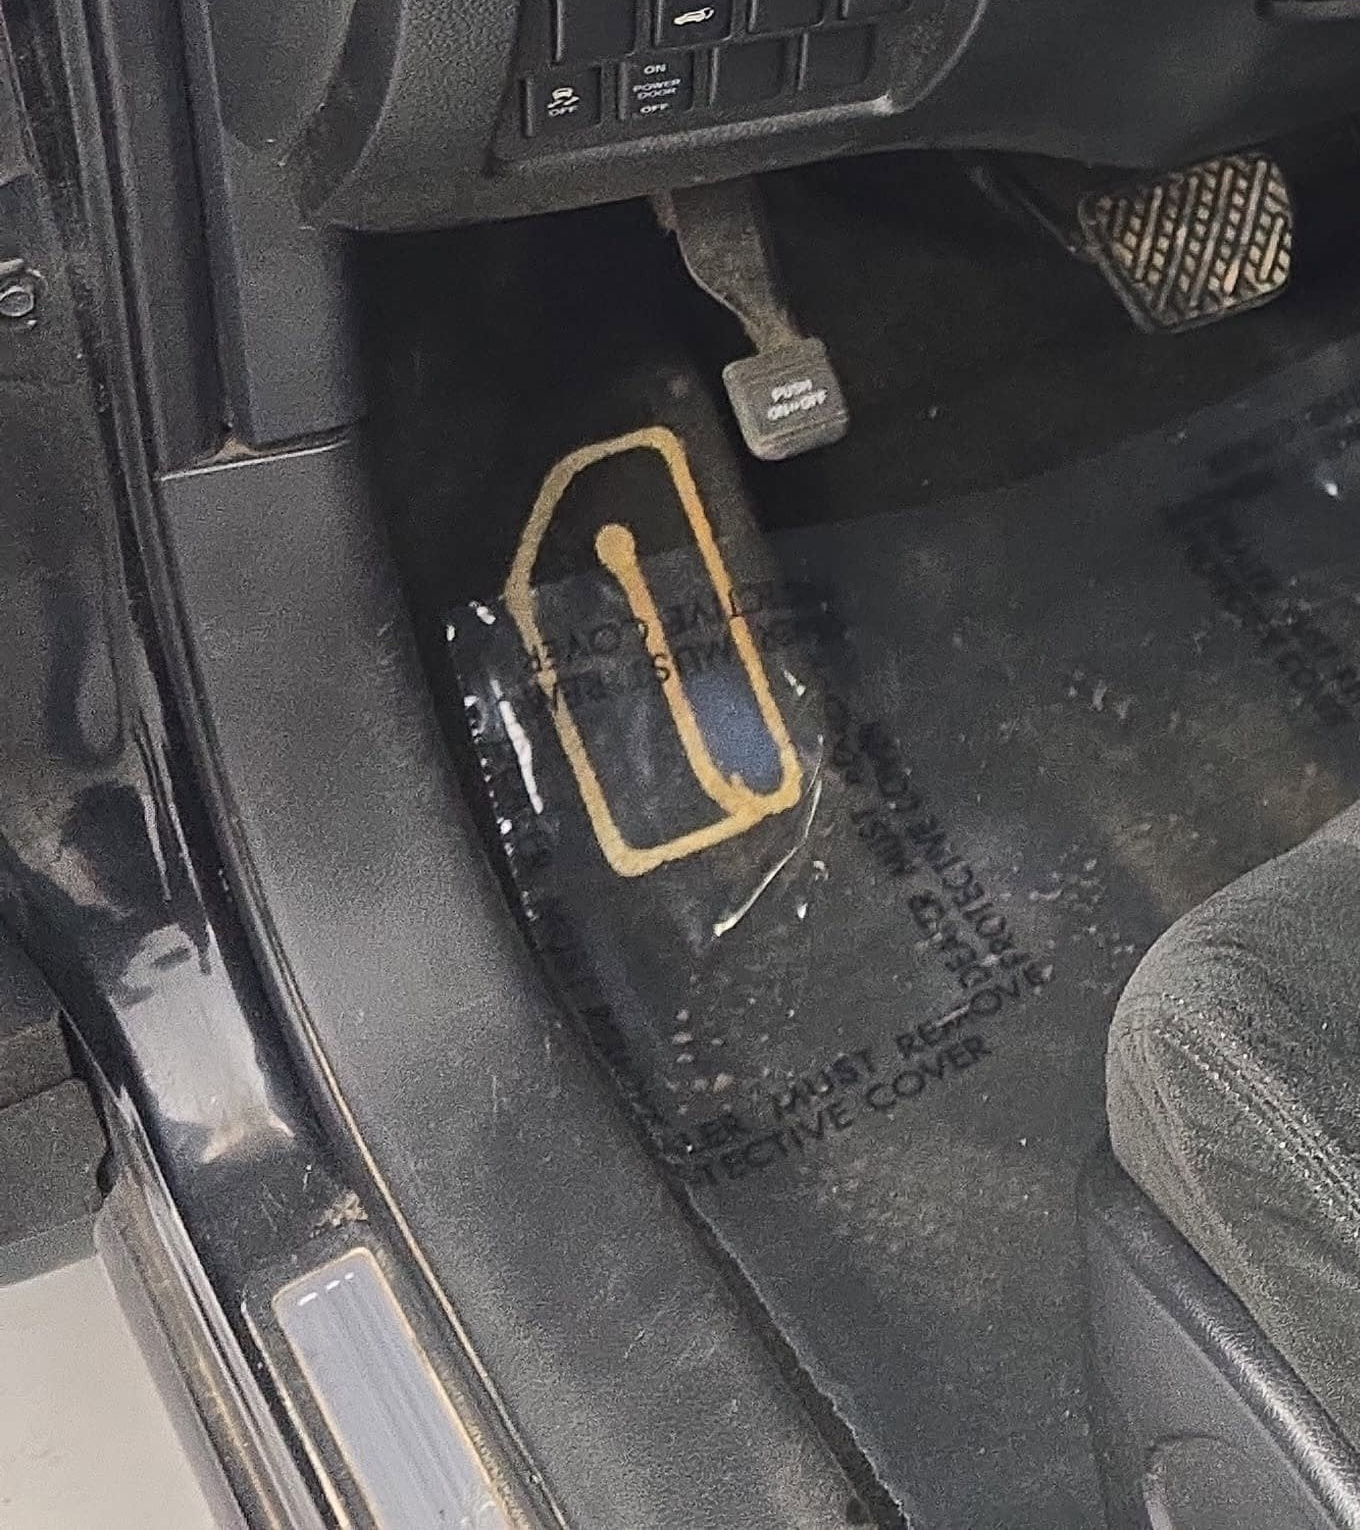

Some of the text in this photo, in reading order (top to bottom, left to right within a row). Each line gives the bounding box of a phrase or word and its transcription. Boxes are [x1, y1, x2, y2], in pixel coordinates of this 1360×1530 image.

[643, 64, 666, 75] ON
[632, 78, 681, 93] POWER
[637, 87, 677, 100] DOOR
[548, 105, 579, 117] OFF
[640, 103, 669, 114] OFF
[865, 1032, 994, 1113] COVER
[774, 1050, 876, 1118] MUST
